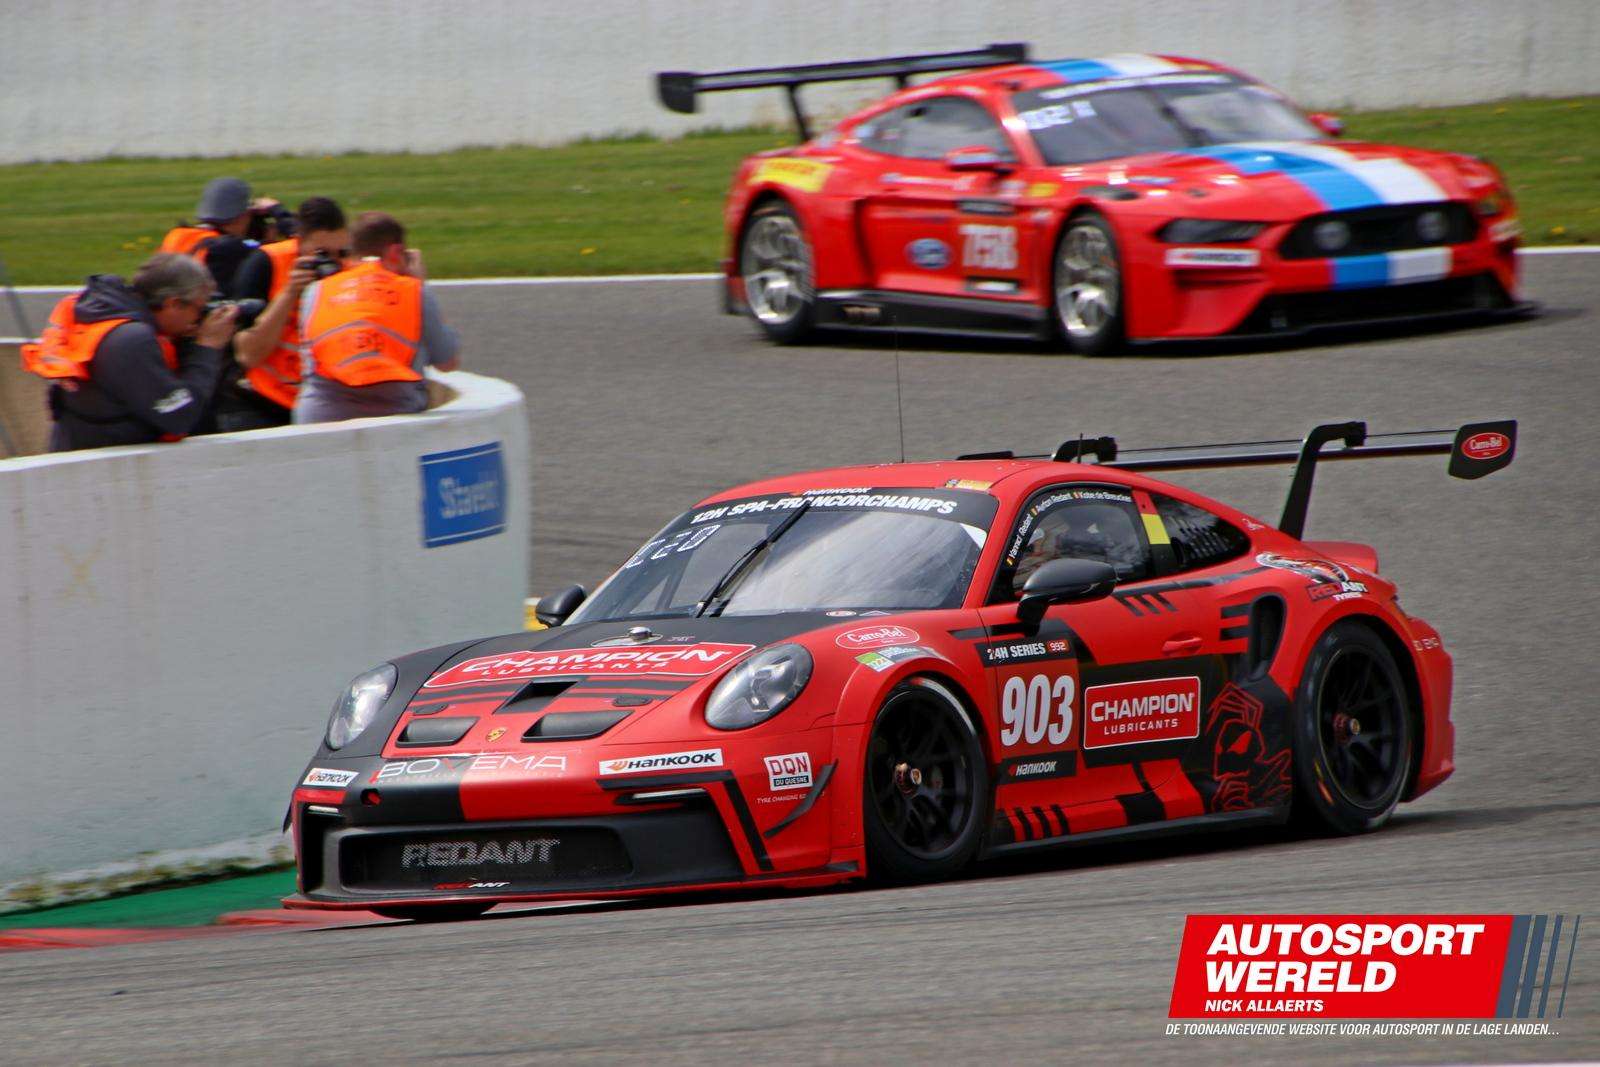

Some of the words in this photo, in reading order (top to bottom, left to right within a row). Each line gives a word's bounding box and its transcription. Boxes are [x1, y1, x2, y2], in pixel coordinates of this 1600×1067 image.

[691, 511, 729, 525] 12H
[462, 649, 727, 673] CHAMPION
[987, 647, 1009, 661] 24H
[1010, 642, 1046, 658] SERIES
[1049, 641, 1066, 652] 992
[1001, 674, 1075, 747] 903
[1091, 692, 1194, 722] CHAMPION
[1103, 718, 1179, 736] LUBRICANTS
[768, 756, 808, 775] DQN
[401, 838, 561, 868] REDANT
